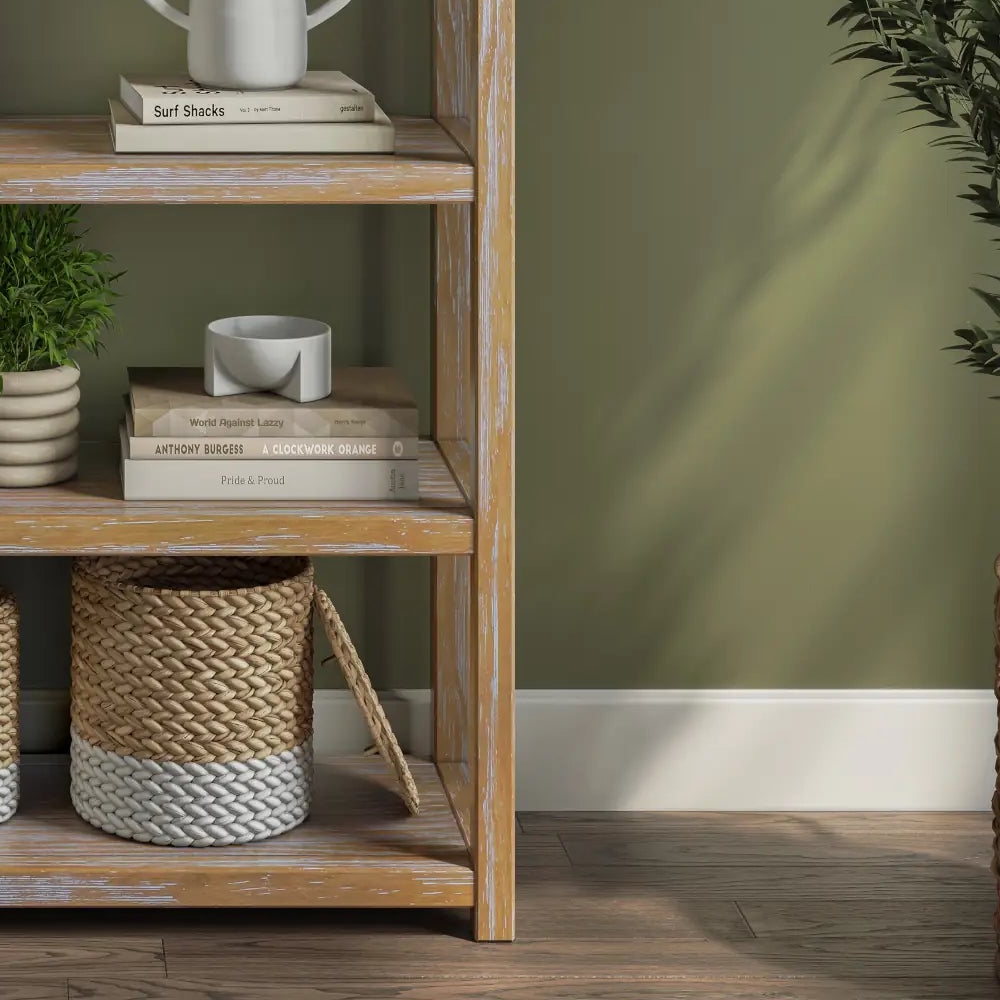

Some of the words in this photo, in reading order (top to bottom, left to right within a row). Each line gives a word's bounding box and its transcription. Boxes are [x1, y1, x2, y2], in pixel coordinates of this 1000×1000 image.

[154, 104, 179, 118] Surf
[183, 104, 225, 118] Shacks
[340, 105, 364, 114] gestalten
[189, 418, 217, 427] World
[219, 418, 255, 429] Against
[257, 418, 284, 429] Lazzy
[155, 443, 201, 455] ANTHONY
[204, 443, 244, 455] BURGESS
[262, 444, 269, 455] A
[272, 444, 335, 455] CLOCKWORK
[338, 444, 377, 455] ORANGE
[221, 475, 245, 485] Pride
[247, 475, 255, 485] &
[257, 475, 285, 485] Proud
